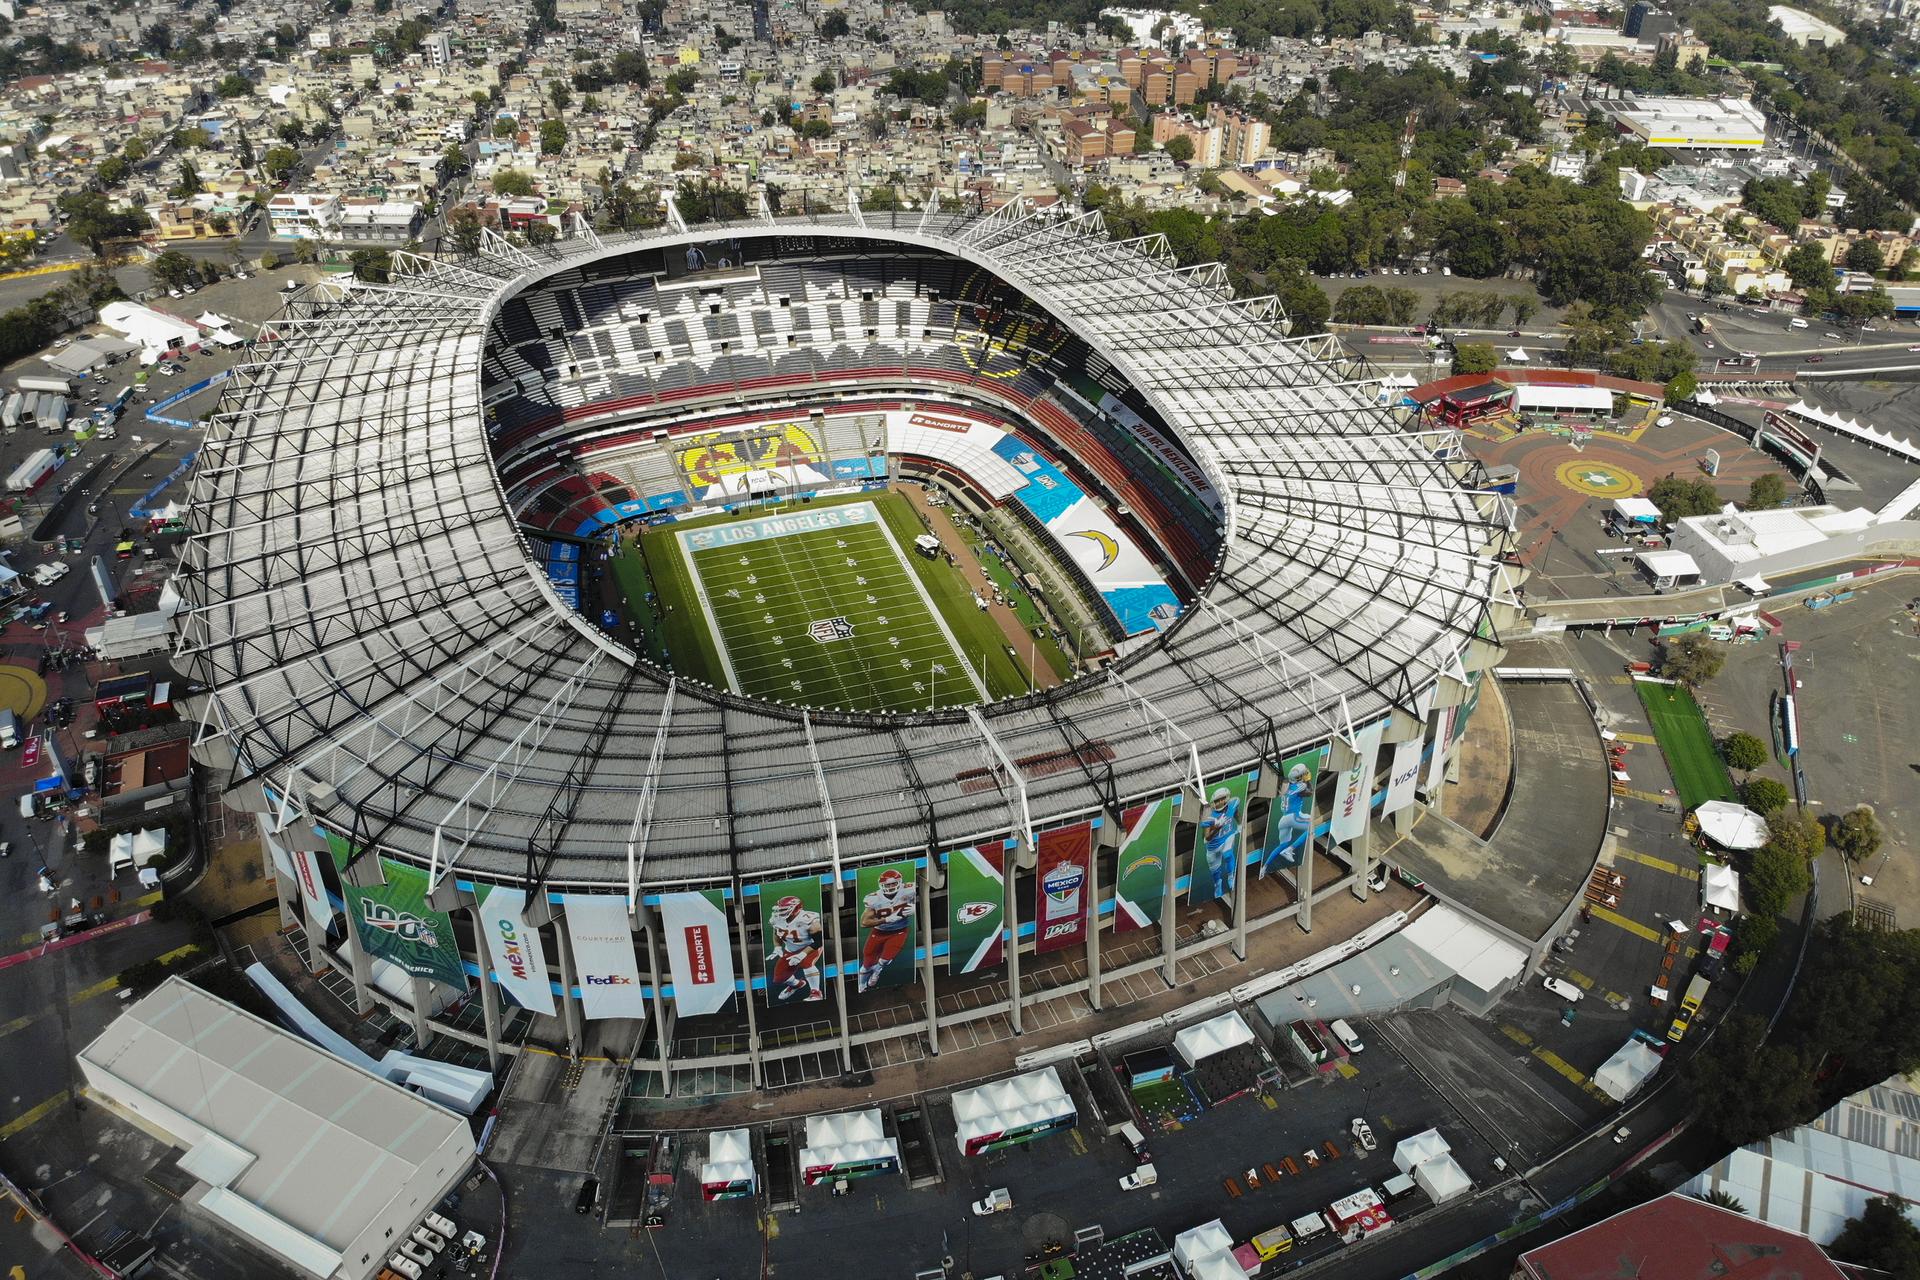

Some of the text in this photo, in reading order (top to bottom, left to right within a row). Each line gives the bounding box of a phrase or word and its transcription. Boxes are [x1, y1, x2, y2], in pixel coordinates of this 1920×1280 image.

[924, 419, 969, 431] BANORTE
[1132, 423, 1210, 492] 2019 NFL MEXICO GAME
[720, 512, 841, 543] LOS ANGELES
[813, 620, 838, 640] NFL
[1394, 764, 1418, 787] VISA
[1047, 877, 1079, 889] MEXICO
[361, 897, 421, 940] 100
[778, 928, 802, 943] 71
[692, 927, 708, 970] BANORTE
[586, 975, 631, 985] FedEx
